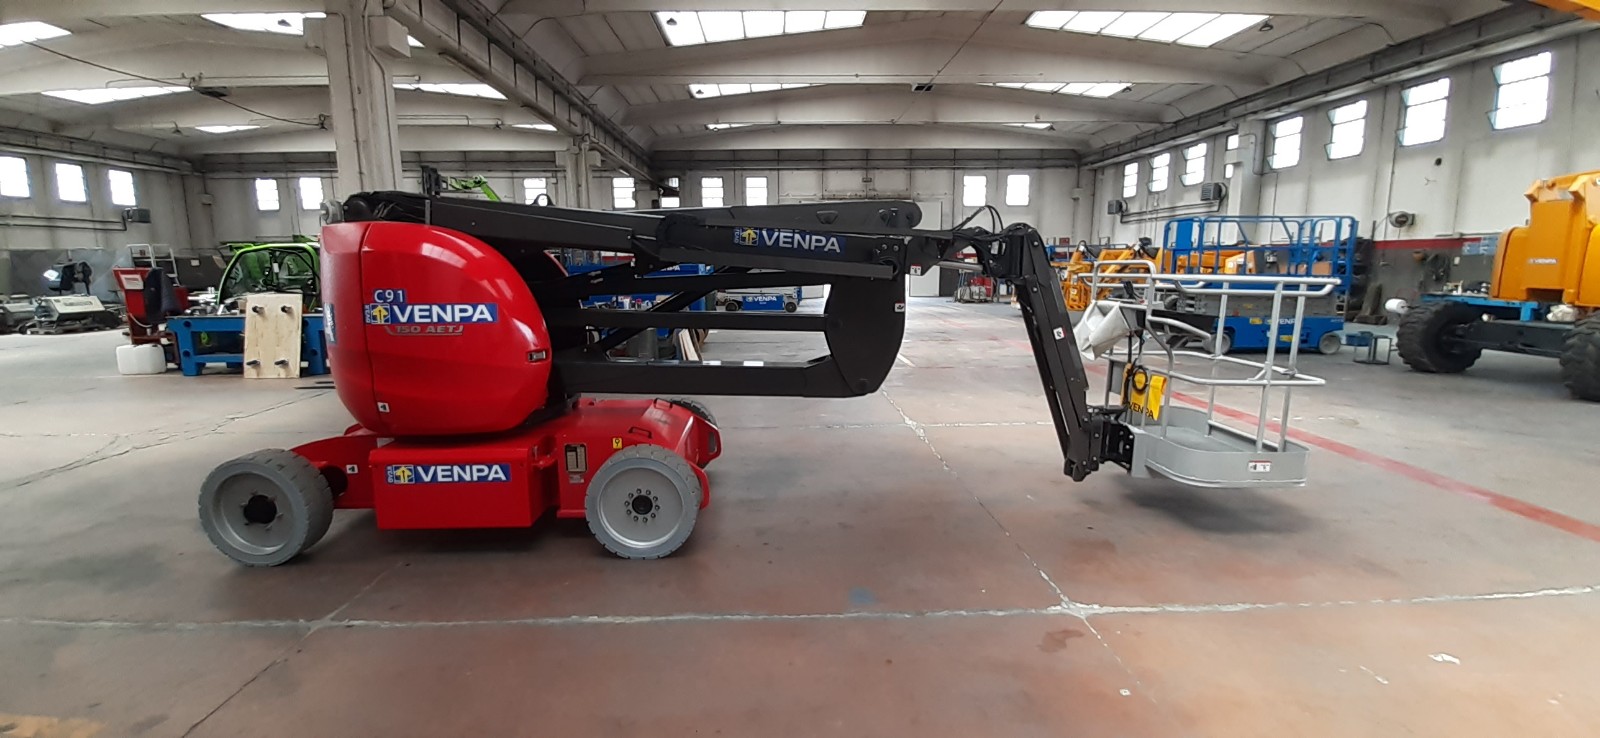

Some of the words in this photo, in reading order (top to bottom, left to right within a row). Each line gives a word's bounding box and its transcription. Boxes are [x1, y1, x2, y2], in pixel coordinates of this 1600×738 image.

[762, 230, 840, 253] VENPA
[374, 289, 404, 303] C91
[393, 304, 494, 323] VENPA
[426, 325, 464, 334] AETJ
[416, 464, 507, 482] VENPA
